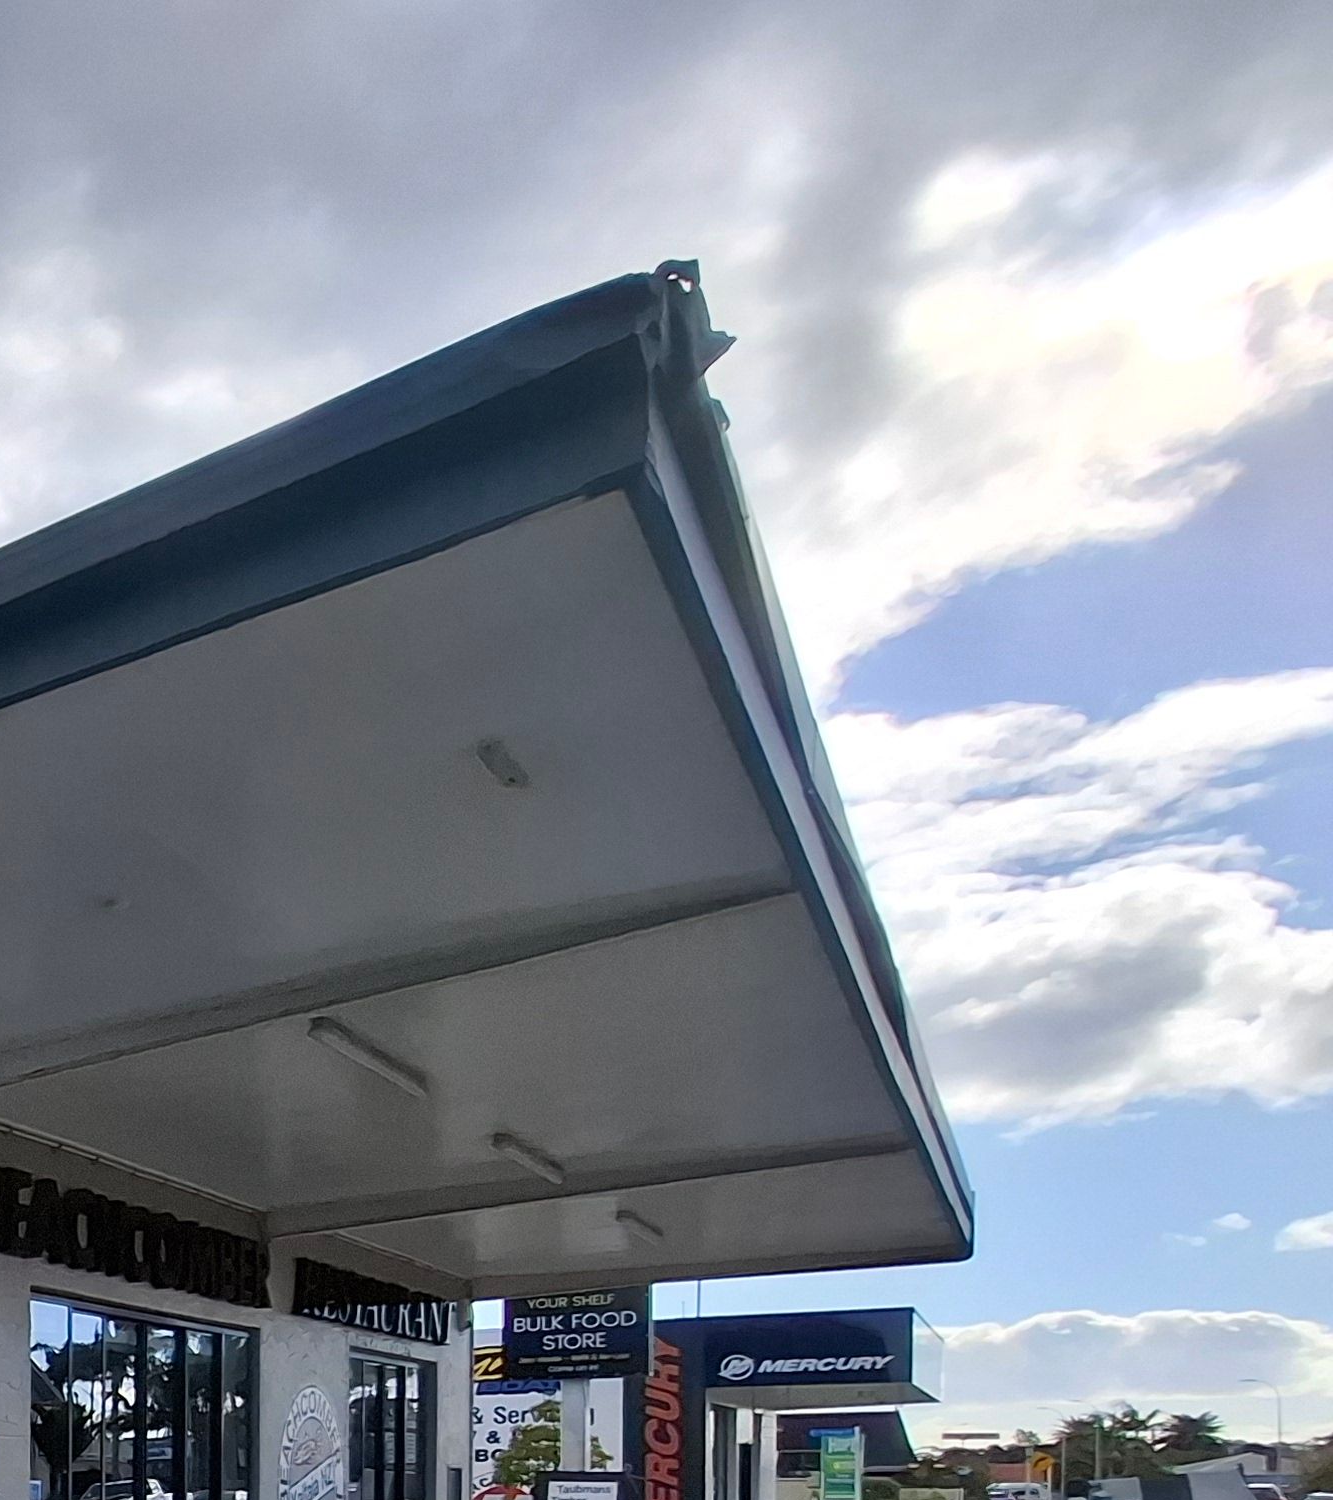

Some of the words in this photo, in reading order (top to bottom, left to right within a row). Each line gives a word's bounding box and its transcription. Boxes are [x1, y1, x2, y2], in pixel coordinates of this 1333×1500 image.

[527, 1296, 568, 1309] YOUR
[572, 1293, 615, 1307] SHELF
[513, 1314, 565, 1333] BULK
[571, 1310, 637, 1329] FOOD
[542, 1332, 608, 1350] STORE
[757, 1355, 895, 1373] MERCURY
